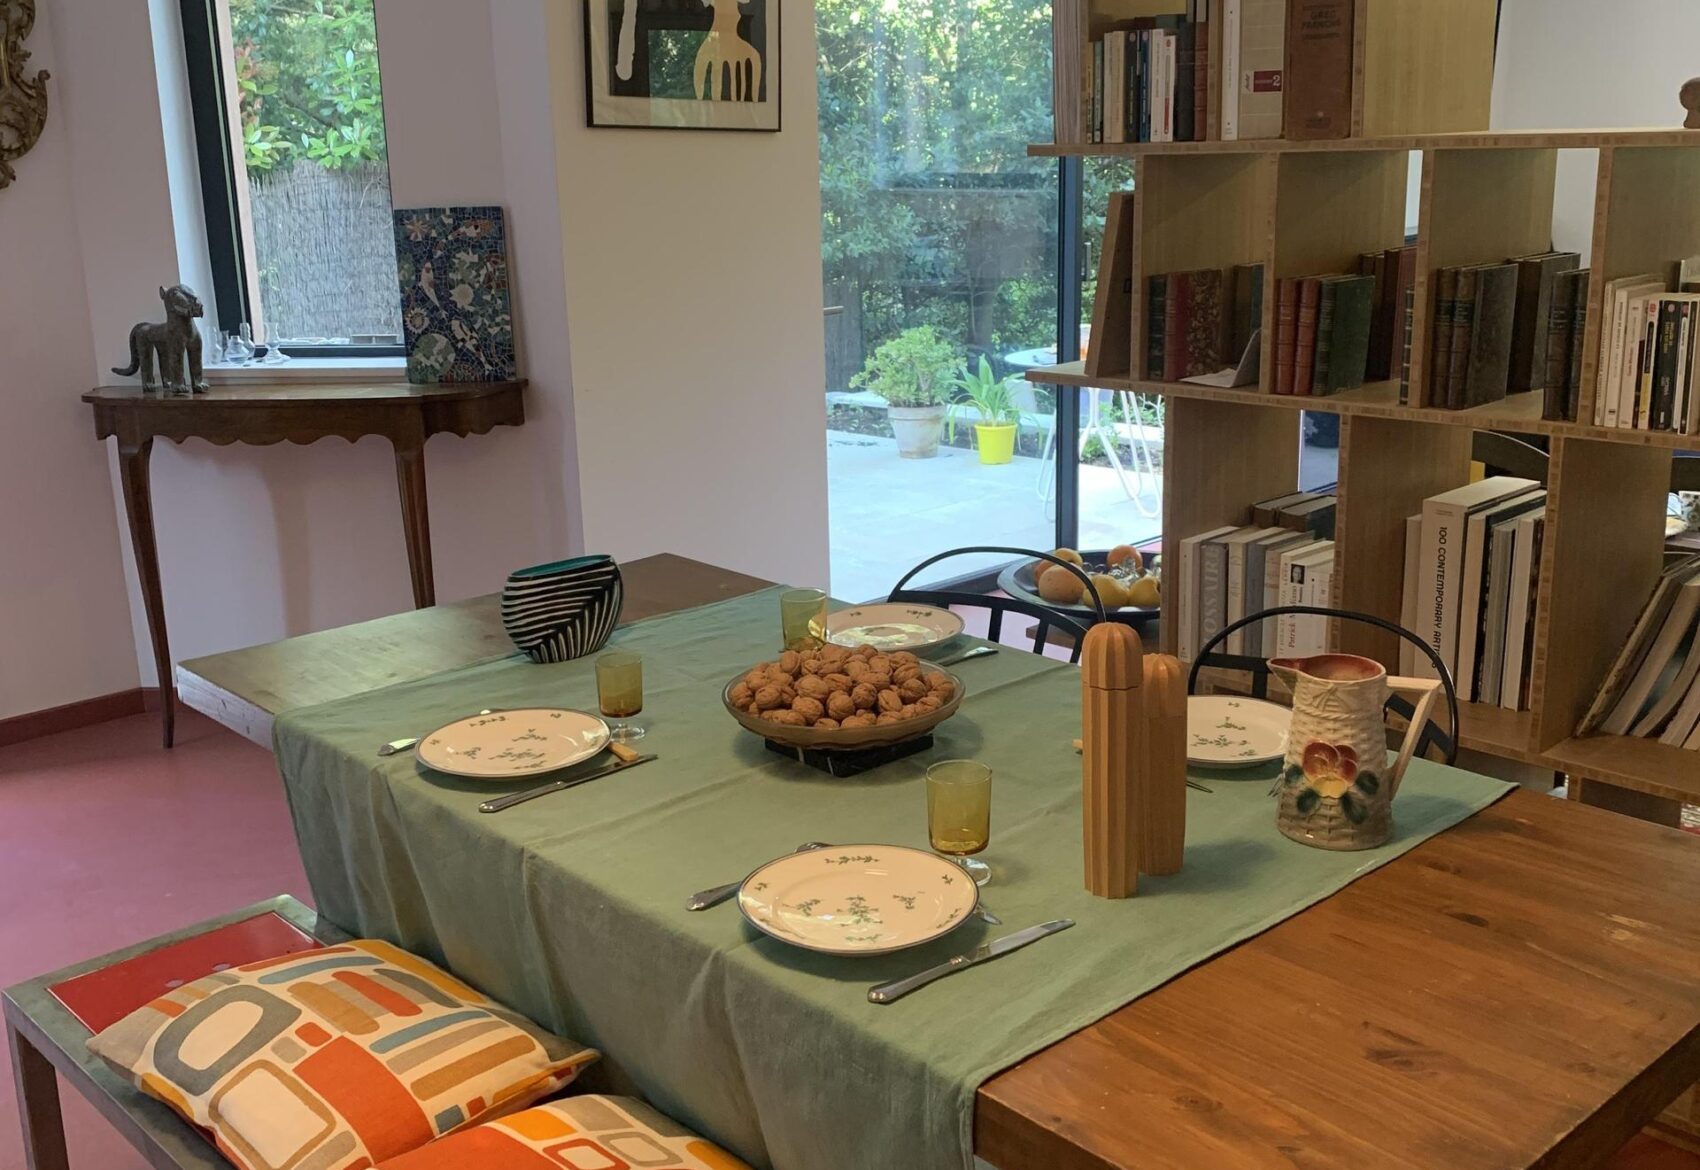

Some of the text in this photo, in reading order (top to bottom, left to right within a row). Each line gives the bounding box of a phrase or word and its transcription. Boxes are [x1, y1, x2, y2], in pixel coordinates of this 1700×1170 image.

[1272, 74, 1281, 87] 2
[1438, 526, 1448, 545] 100
[1203, 546, 1219, 646] LOSSAIRE
[1433, 547, 1446, 628] CONTEMPORARY
[1287, 622, 1296, 648] Patrick
